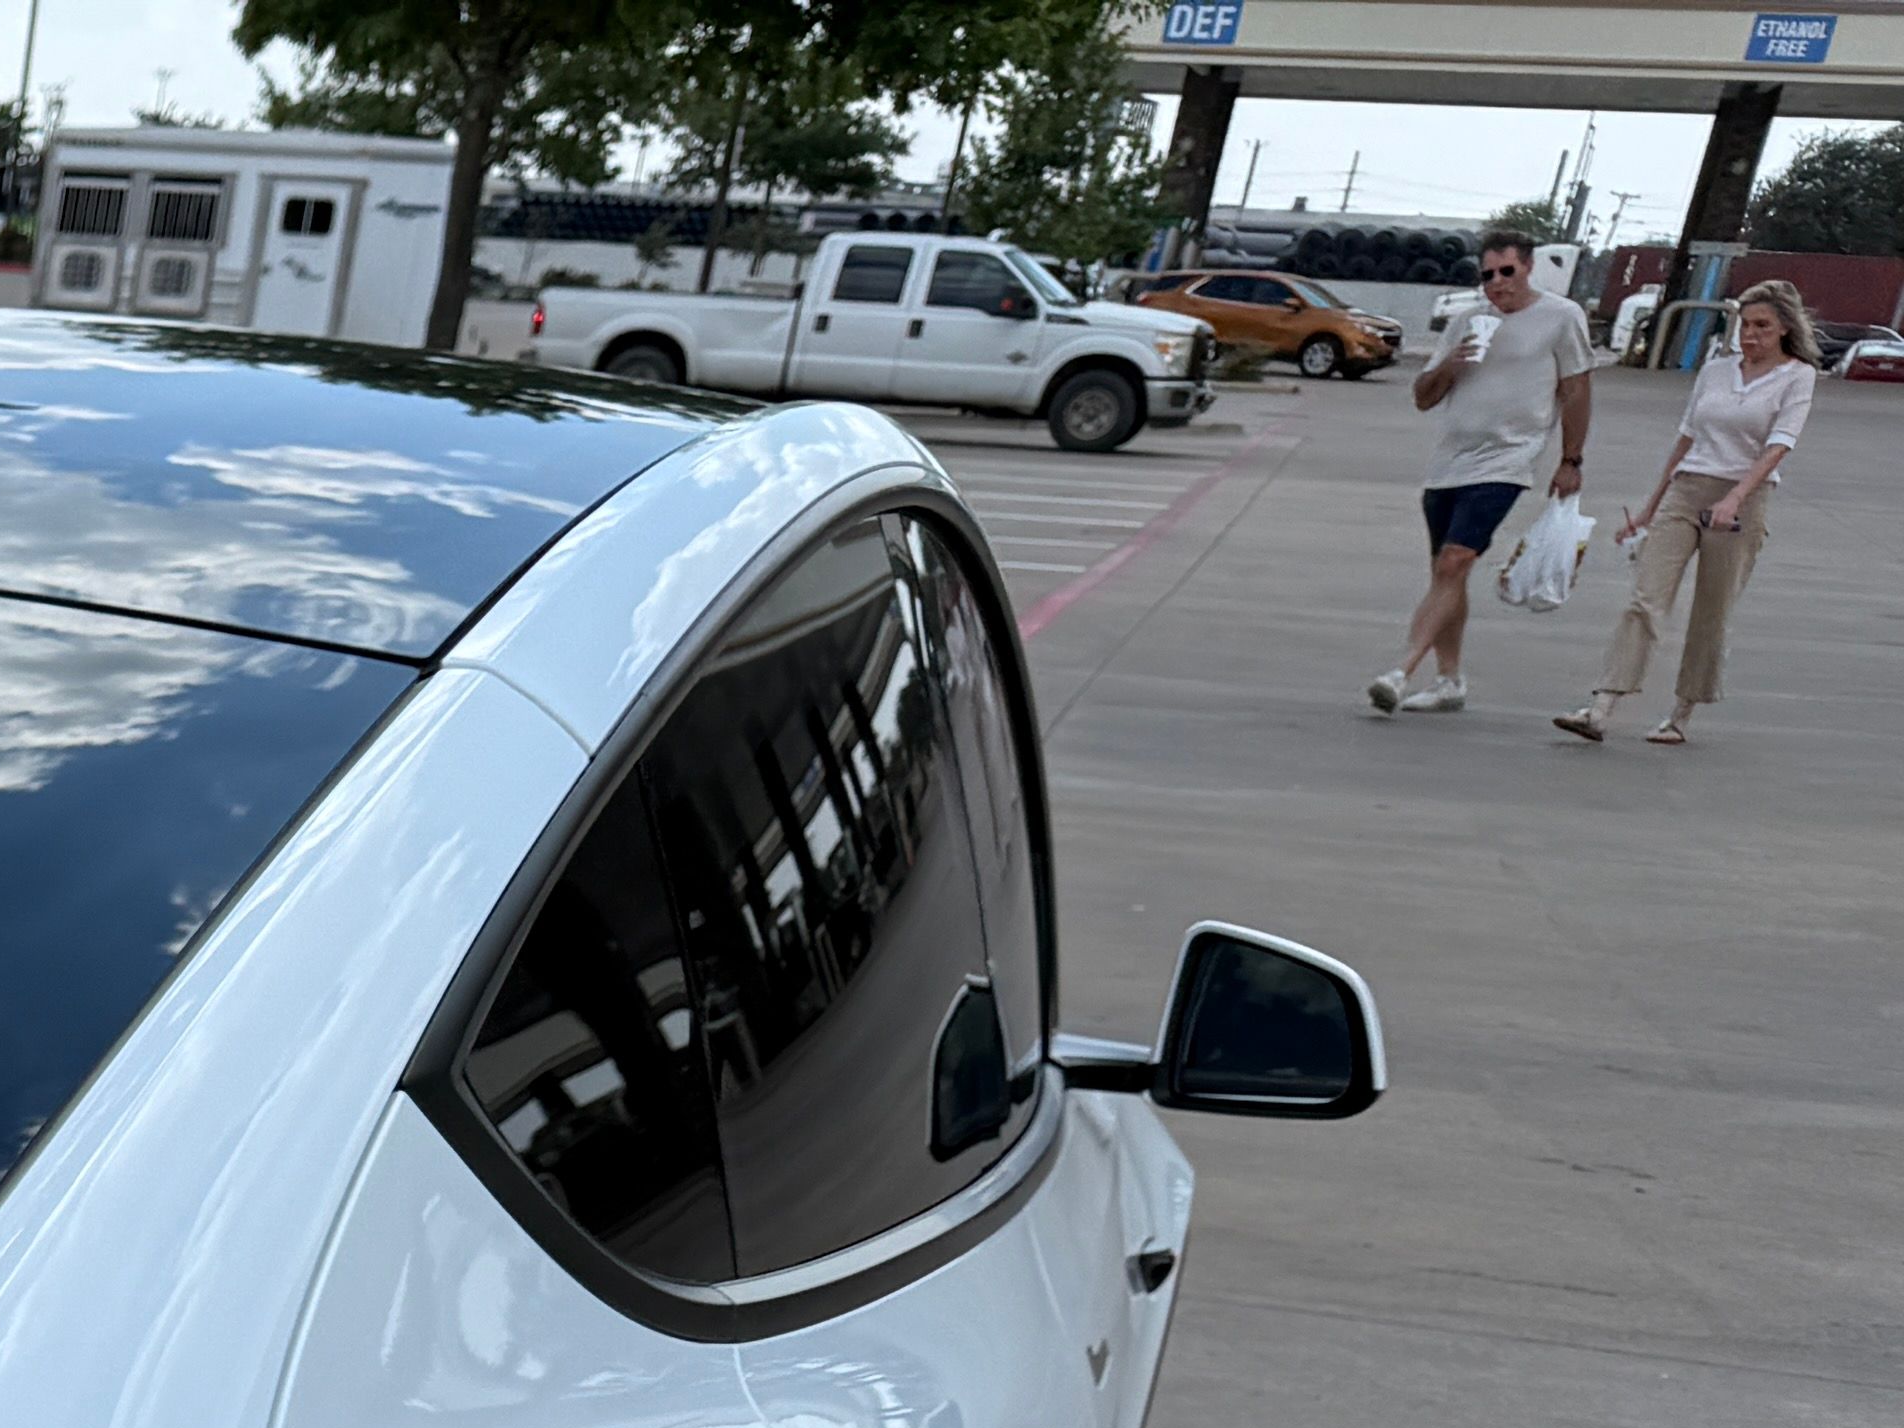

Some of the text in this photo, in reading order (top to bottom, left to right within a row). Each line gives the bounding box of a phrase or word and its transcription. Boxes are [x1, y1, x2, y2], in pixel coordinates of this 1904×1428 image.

[1167, 4, 1237, 39] DEF
[1757, 20, 1827, 39] ETHANOL
[1765, 39, 1810, 57] FREE
